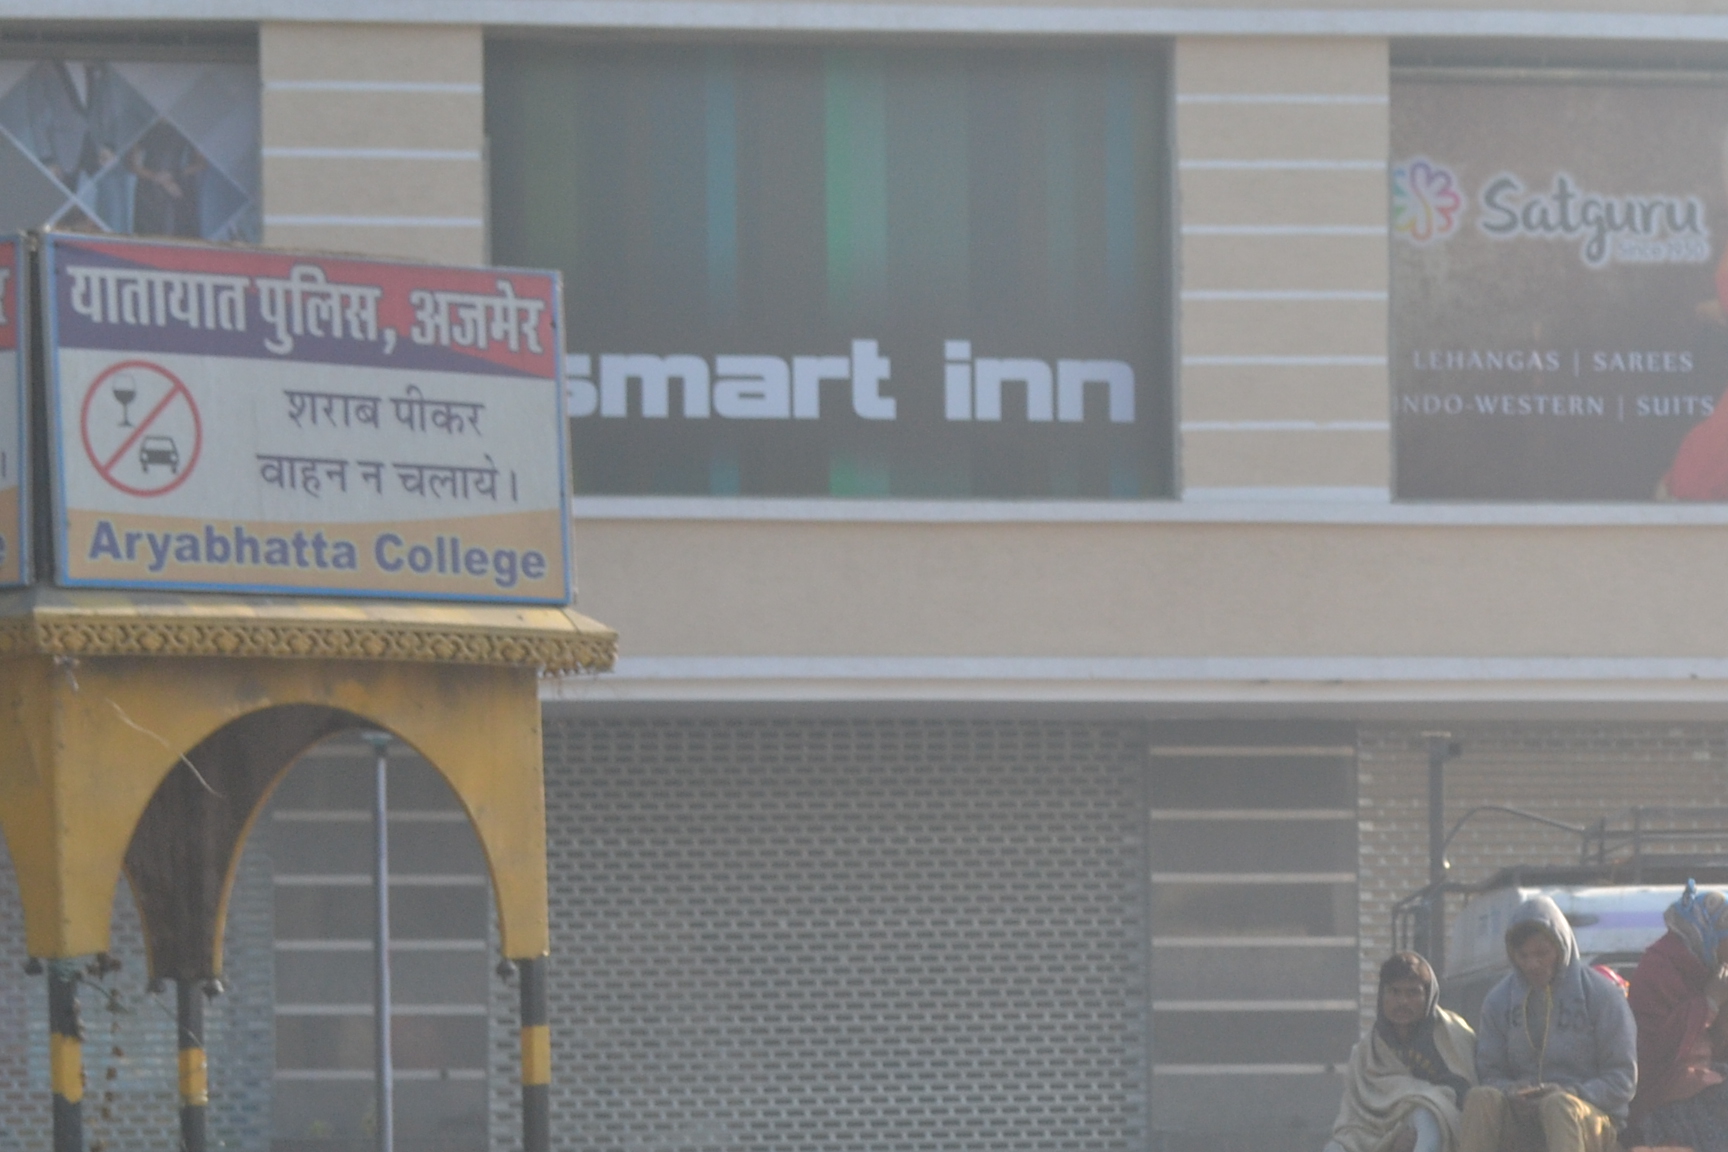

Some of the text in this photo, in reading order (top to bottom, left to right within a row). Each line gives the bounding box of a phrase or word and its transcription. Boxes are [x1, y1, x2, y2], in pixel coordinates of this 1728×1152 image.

[1481, 176, 1706, 265] Satguru
[66, 263, 250, 330] यातायात
[408, 280, 546, 354] अजमेर
[943, 339, 1136, 422] inn
[1412, 351, 1695, 373] LEHANGAS SAREES
[282, 384, 486, 437] शराब पीकर
[1635, 394, 1716, 417] SUITS
[256, 453, 349, 496] वाहन
[356, 458, 384, 494] न
[88, 520, 548, 587] Aryabhatta College
